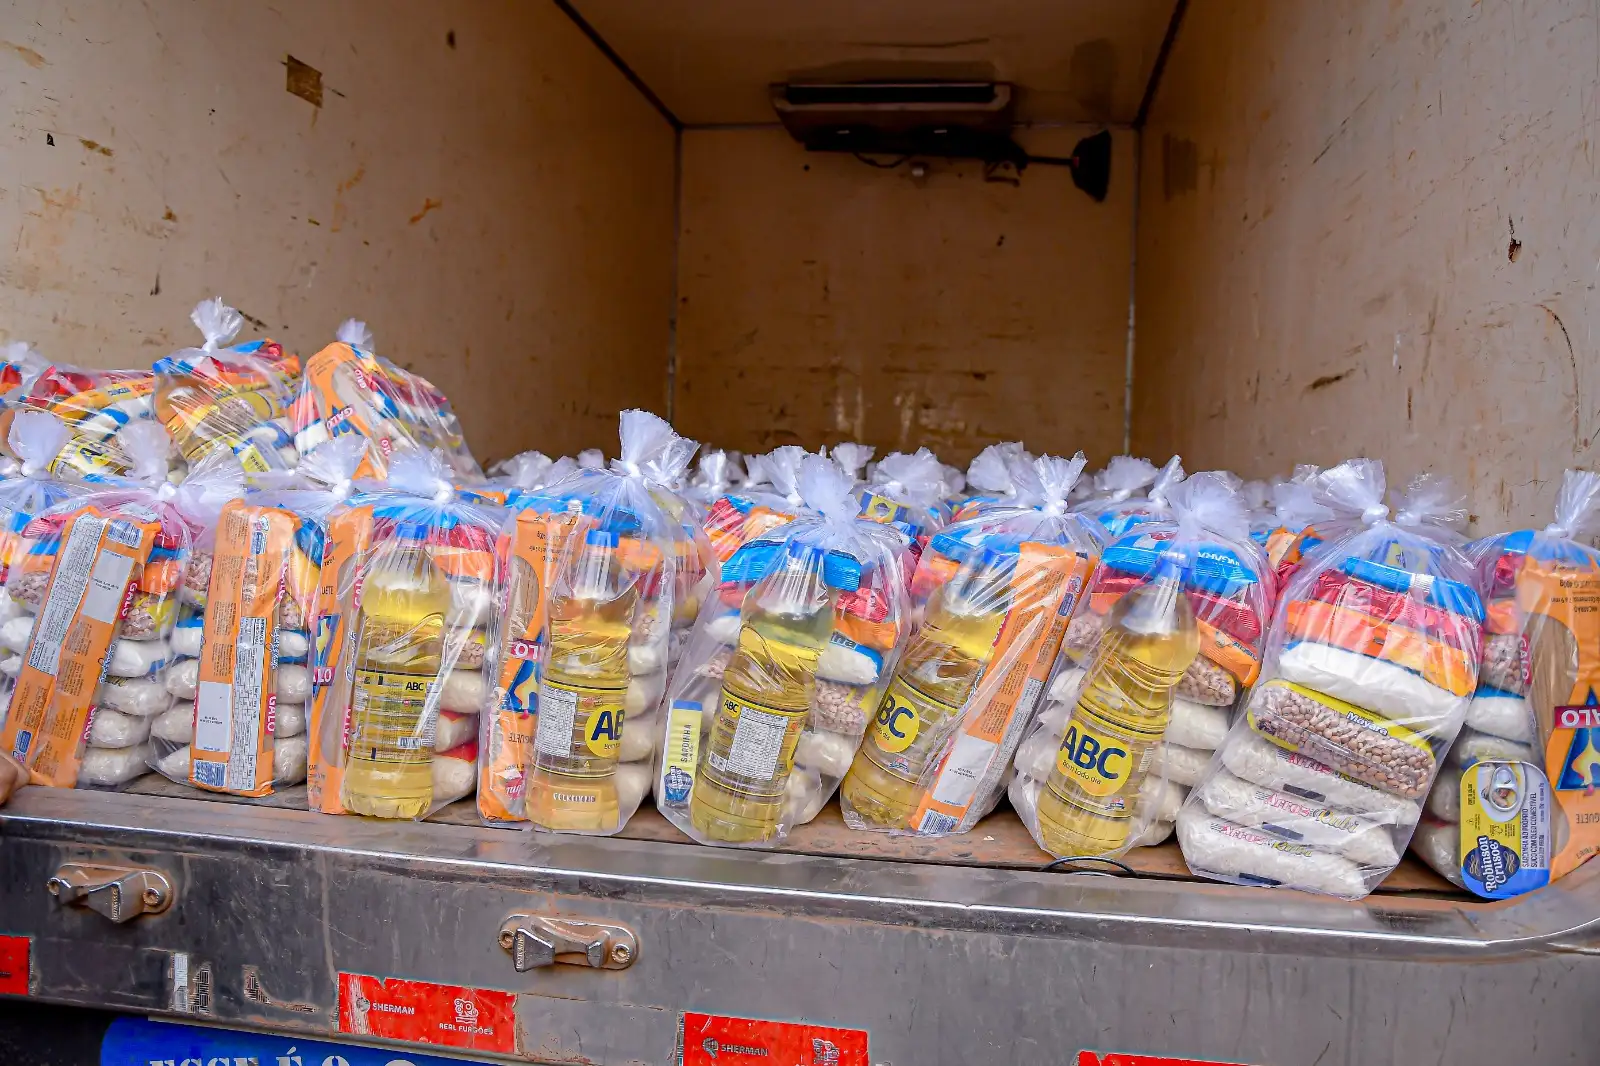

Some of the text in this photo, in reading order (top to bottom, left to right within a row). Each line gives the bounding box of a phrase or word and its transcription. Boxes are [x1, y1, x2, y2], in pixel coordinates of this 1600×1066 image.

[405, 681, 425, 691] ABC
[266, 694, 277, 733] GALO
[723, 699, 740, 713] ABC
[680, 724, 693, 763] SARDINHA
[1059, 725, 1127, 780] ABC
[1478, 836, 1498, 892] Robinson
[1489, 841, 1507, 885] Crusoe
[372, 1002, 415, 1015] SHERMAN
[438, 1023, 494, 1036] REAL FURGÕES
[720, 1043, 769, 1057] SHERMAN
